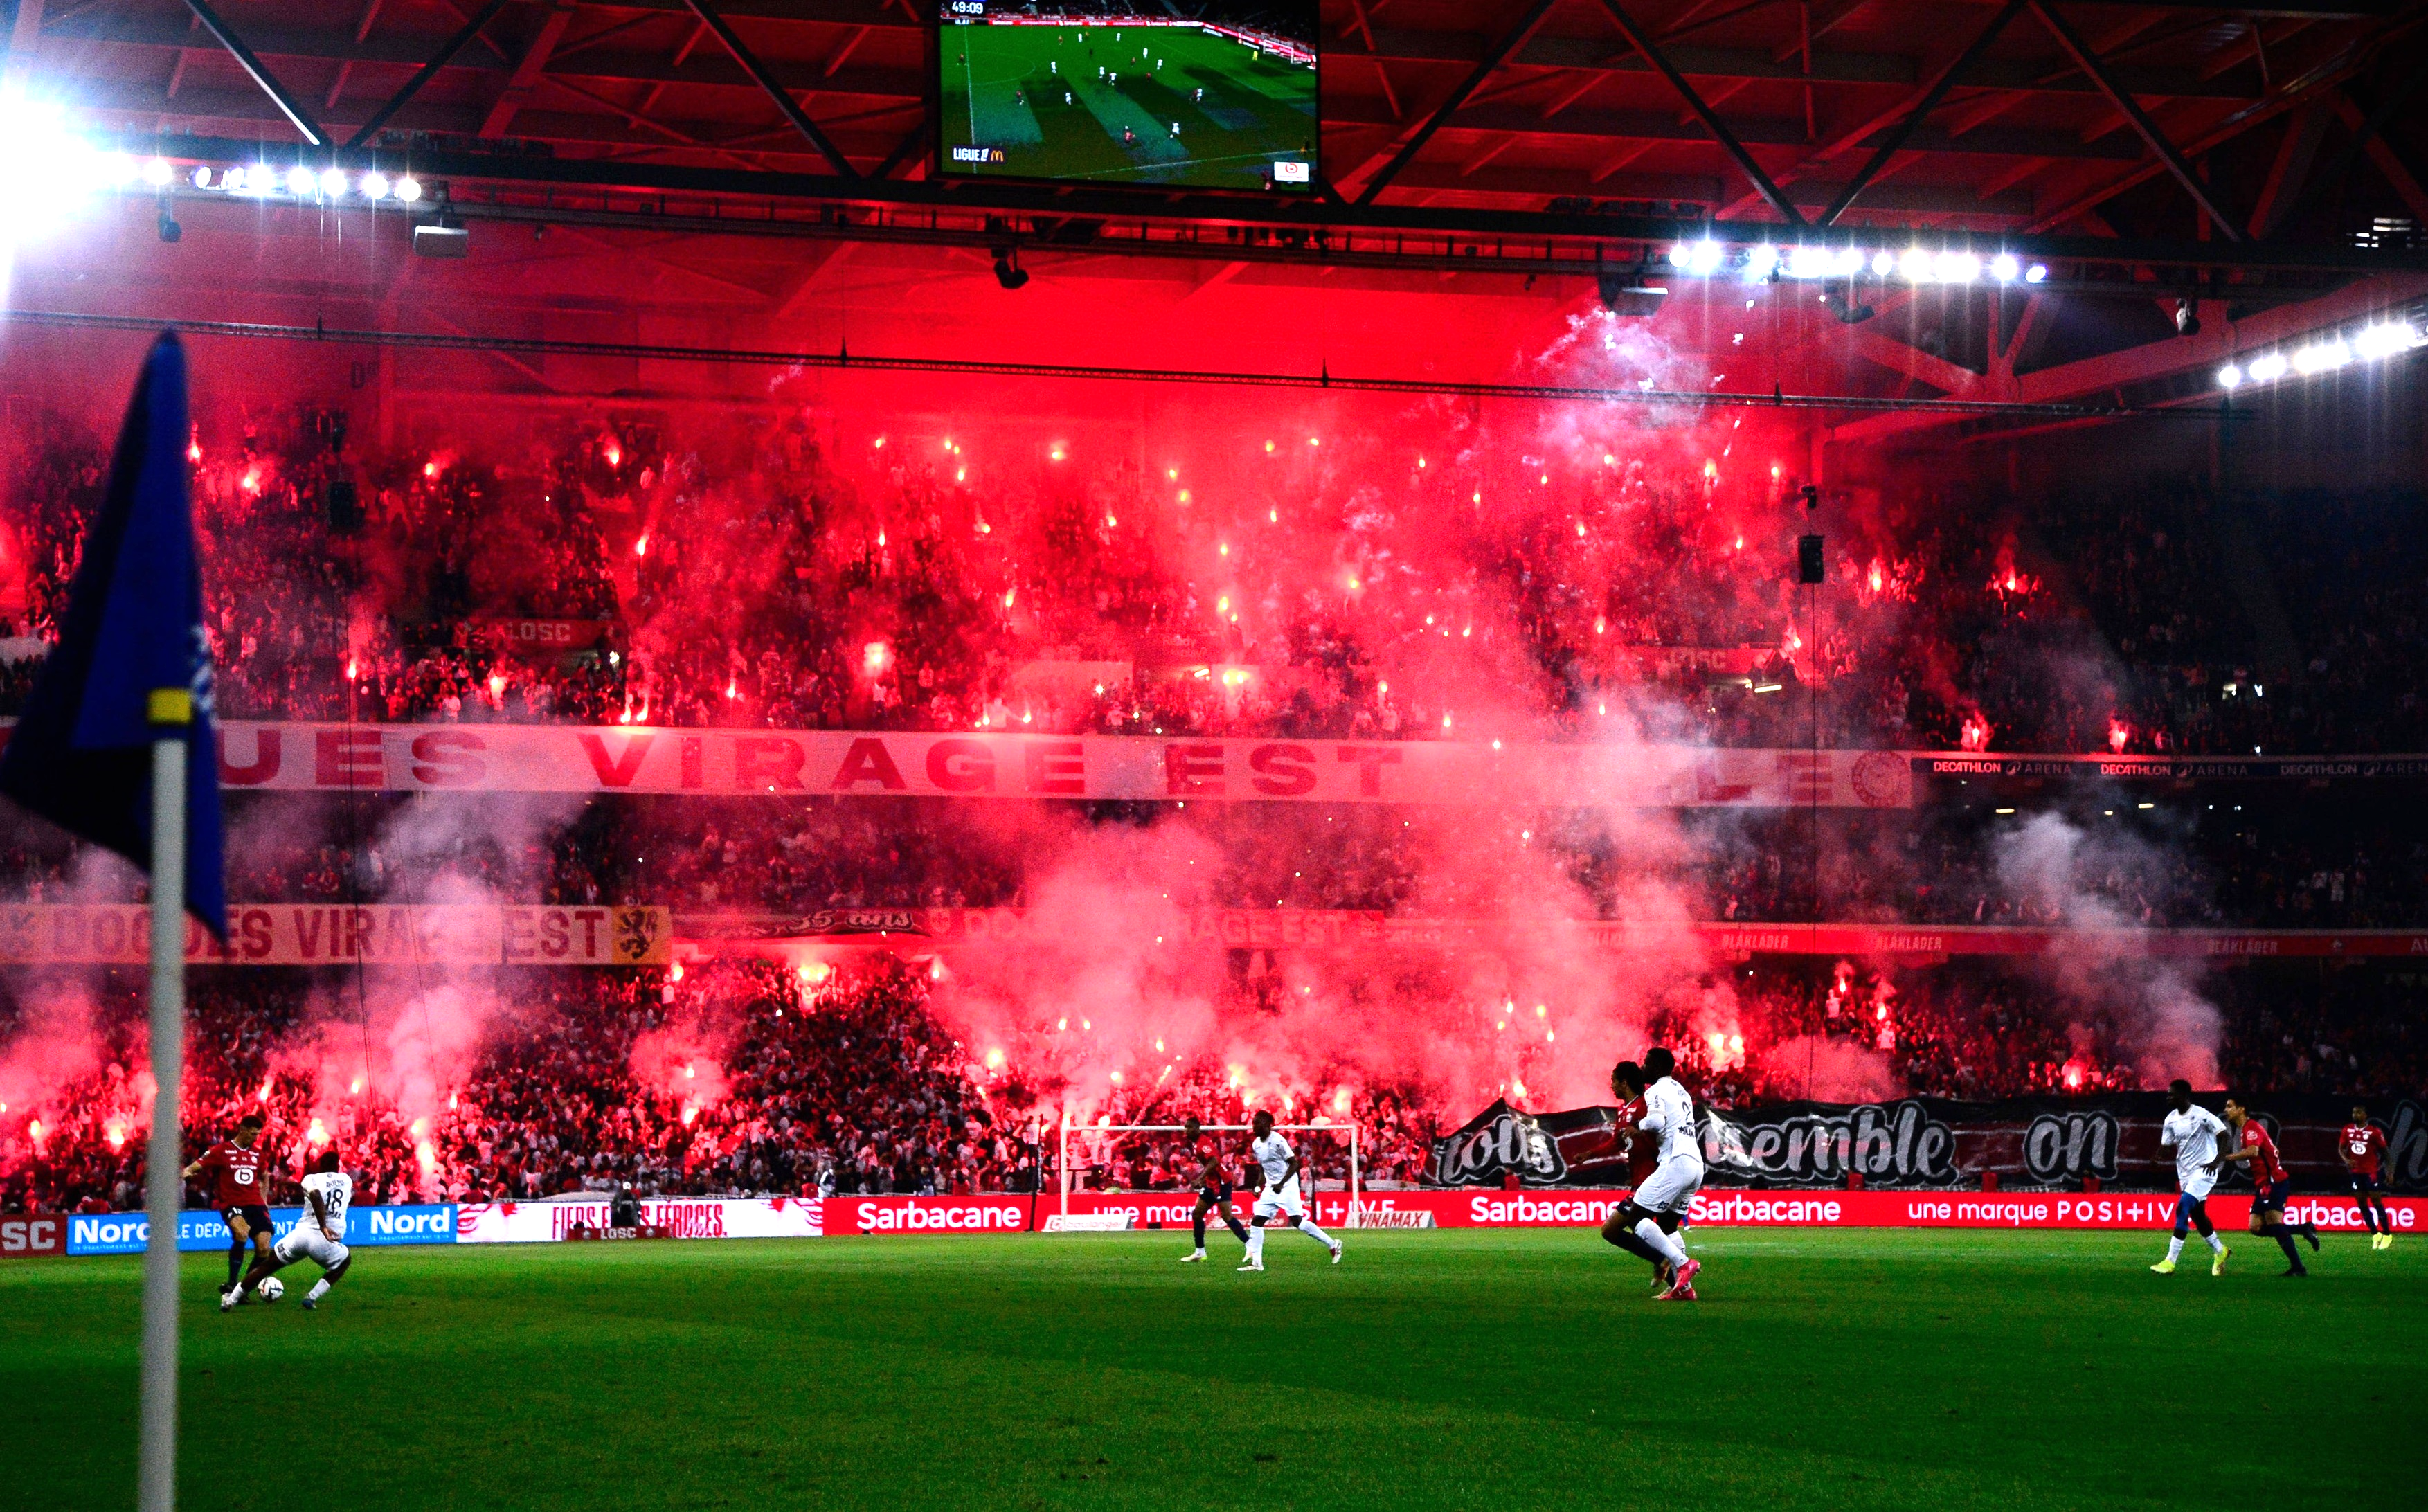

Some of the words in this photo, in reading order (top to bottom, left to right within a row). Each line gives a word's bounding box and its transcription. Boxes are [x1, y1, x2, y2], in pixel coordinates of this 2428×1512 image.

[952, 1, 983, 14] 49:09
[953, 147, 980, 161] LIGUE
[508, 622, 570, 641] LOSC
[216, 728, 488, 786] UES
[578, 734, 1086, 793] VIRAGE
[1164, 743, 1403, 797] EST
[1933, 762, 2001, 773] DECATHLON
[2024, 764, 2072, 773] ARENA
[2101, 764, 2171, 775] DECATHLON
[2196, 765, 2247, 775] ARENA
[2280, 765, 2357, 775] DECATHLON
[505, 910, 603, 957] EST
[2029, 1117, 2107, 1173] on
[326, 1189, 343, 1212] 18
[1471, 1196, 1618, 1221] Sarbacane
[1689, 1195, 1841, 1221] Sarbacane
[370, 1210, 450, 1234] Nord
[856, 1200, 1022, 1230] Sarbacane
[1908, 1203, 1951, 1220] une
[1958, 1203, 2048, 1226] marque
[1, 1221, 55, 1250] SC
[600, 1227, 637, 1239] LOSC
